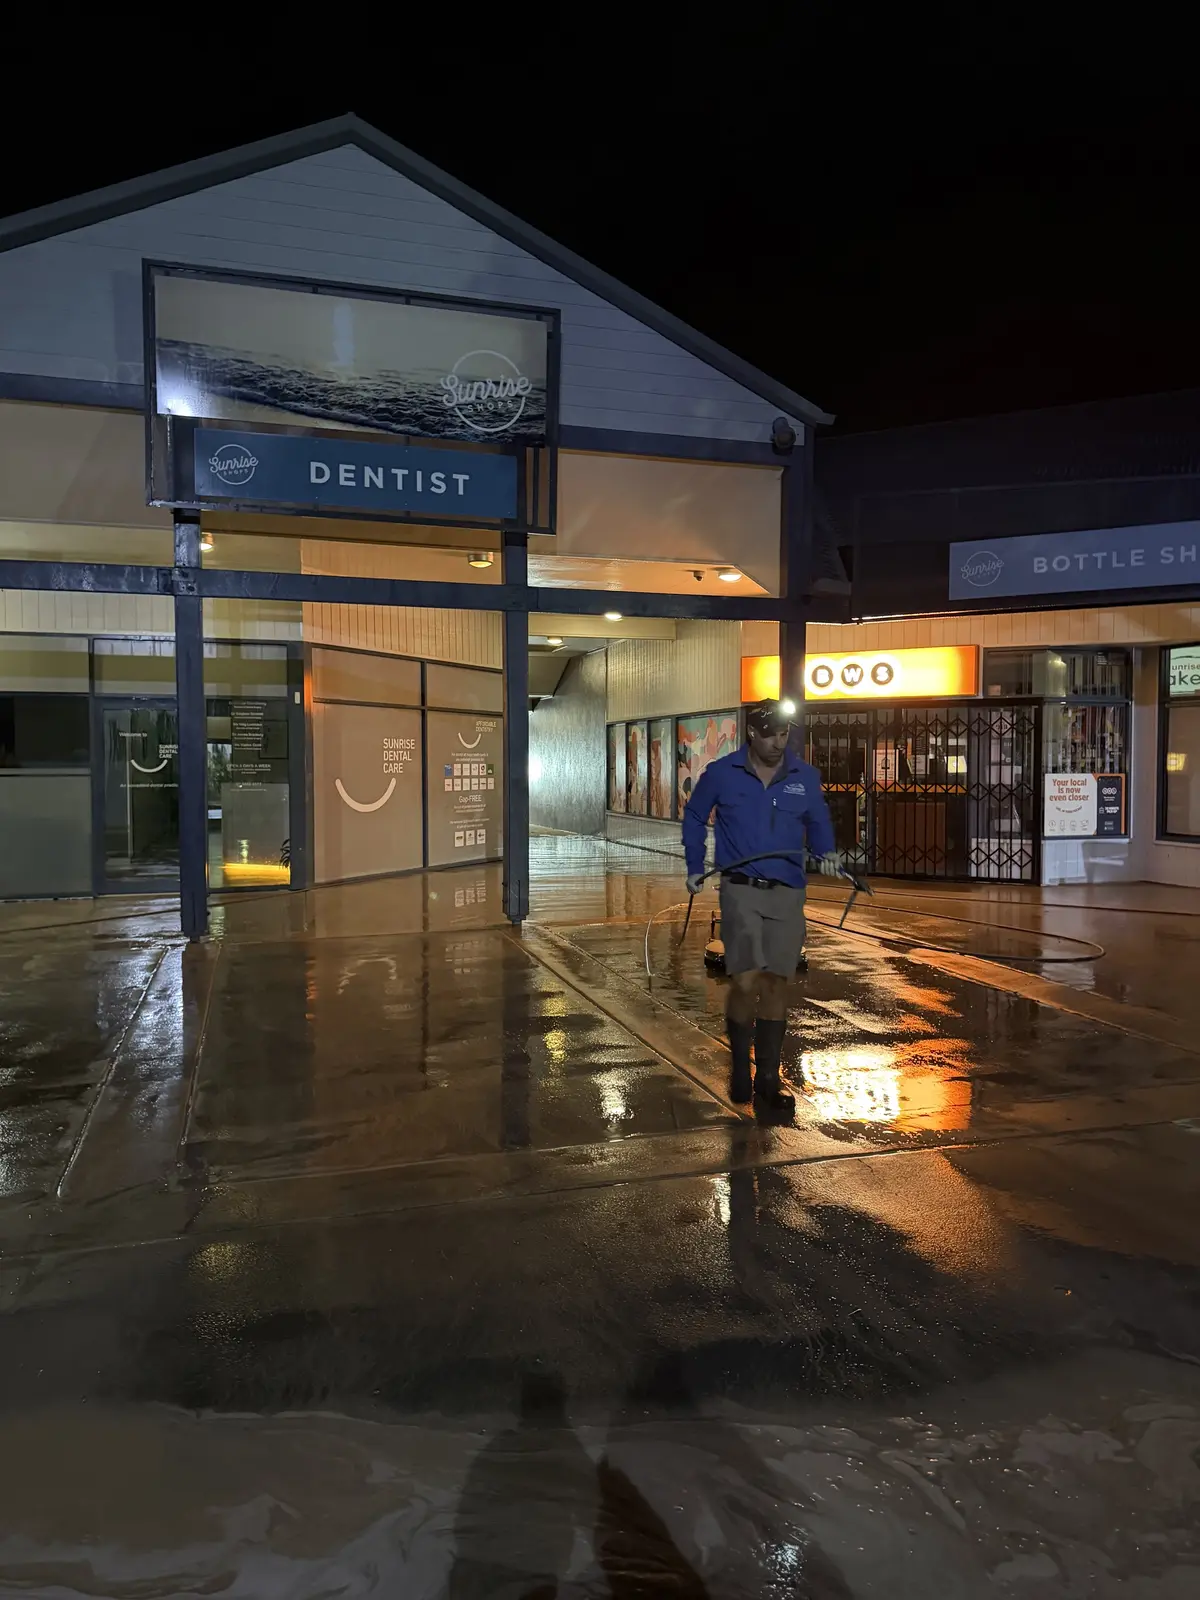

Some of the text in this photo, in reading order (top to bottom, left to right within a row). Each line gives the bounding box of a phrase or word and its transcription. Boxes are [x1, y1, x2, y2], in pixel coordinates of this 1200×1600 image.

[441, 374, 532, 406] Sunrise
[468, 400, 513, 413] SHOPS
[208, 456, 259, 473] Sunrise
[310, 461, 470, 495] DENTIST
[1033, 544, 1197, 573] BOTTLE SH
[960, 559, 1004, 579] Sunrise
[813, 663, 892, 687] BWS
[1171, 663, 1200, 671] unrise
[1169, 670, 1200, 686] ake
[383, 738, 416, 749] SUNRISE
[383, 750, 413, 761] DENTAL
[383, 762, 404, 774] CARE
[1052, 778, 1087, 787] Your local
